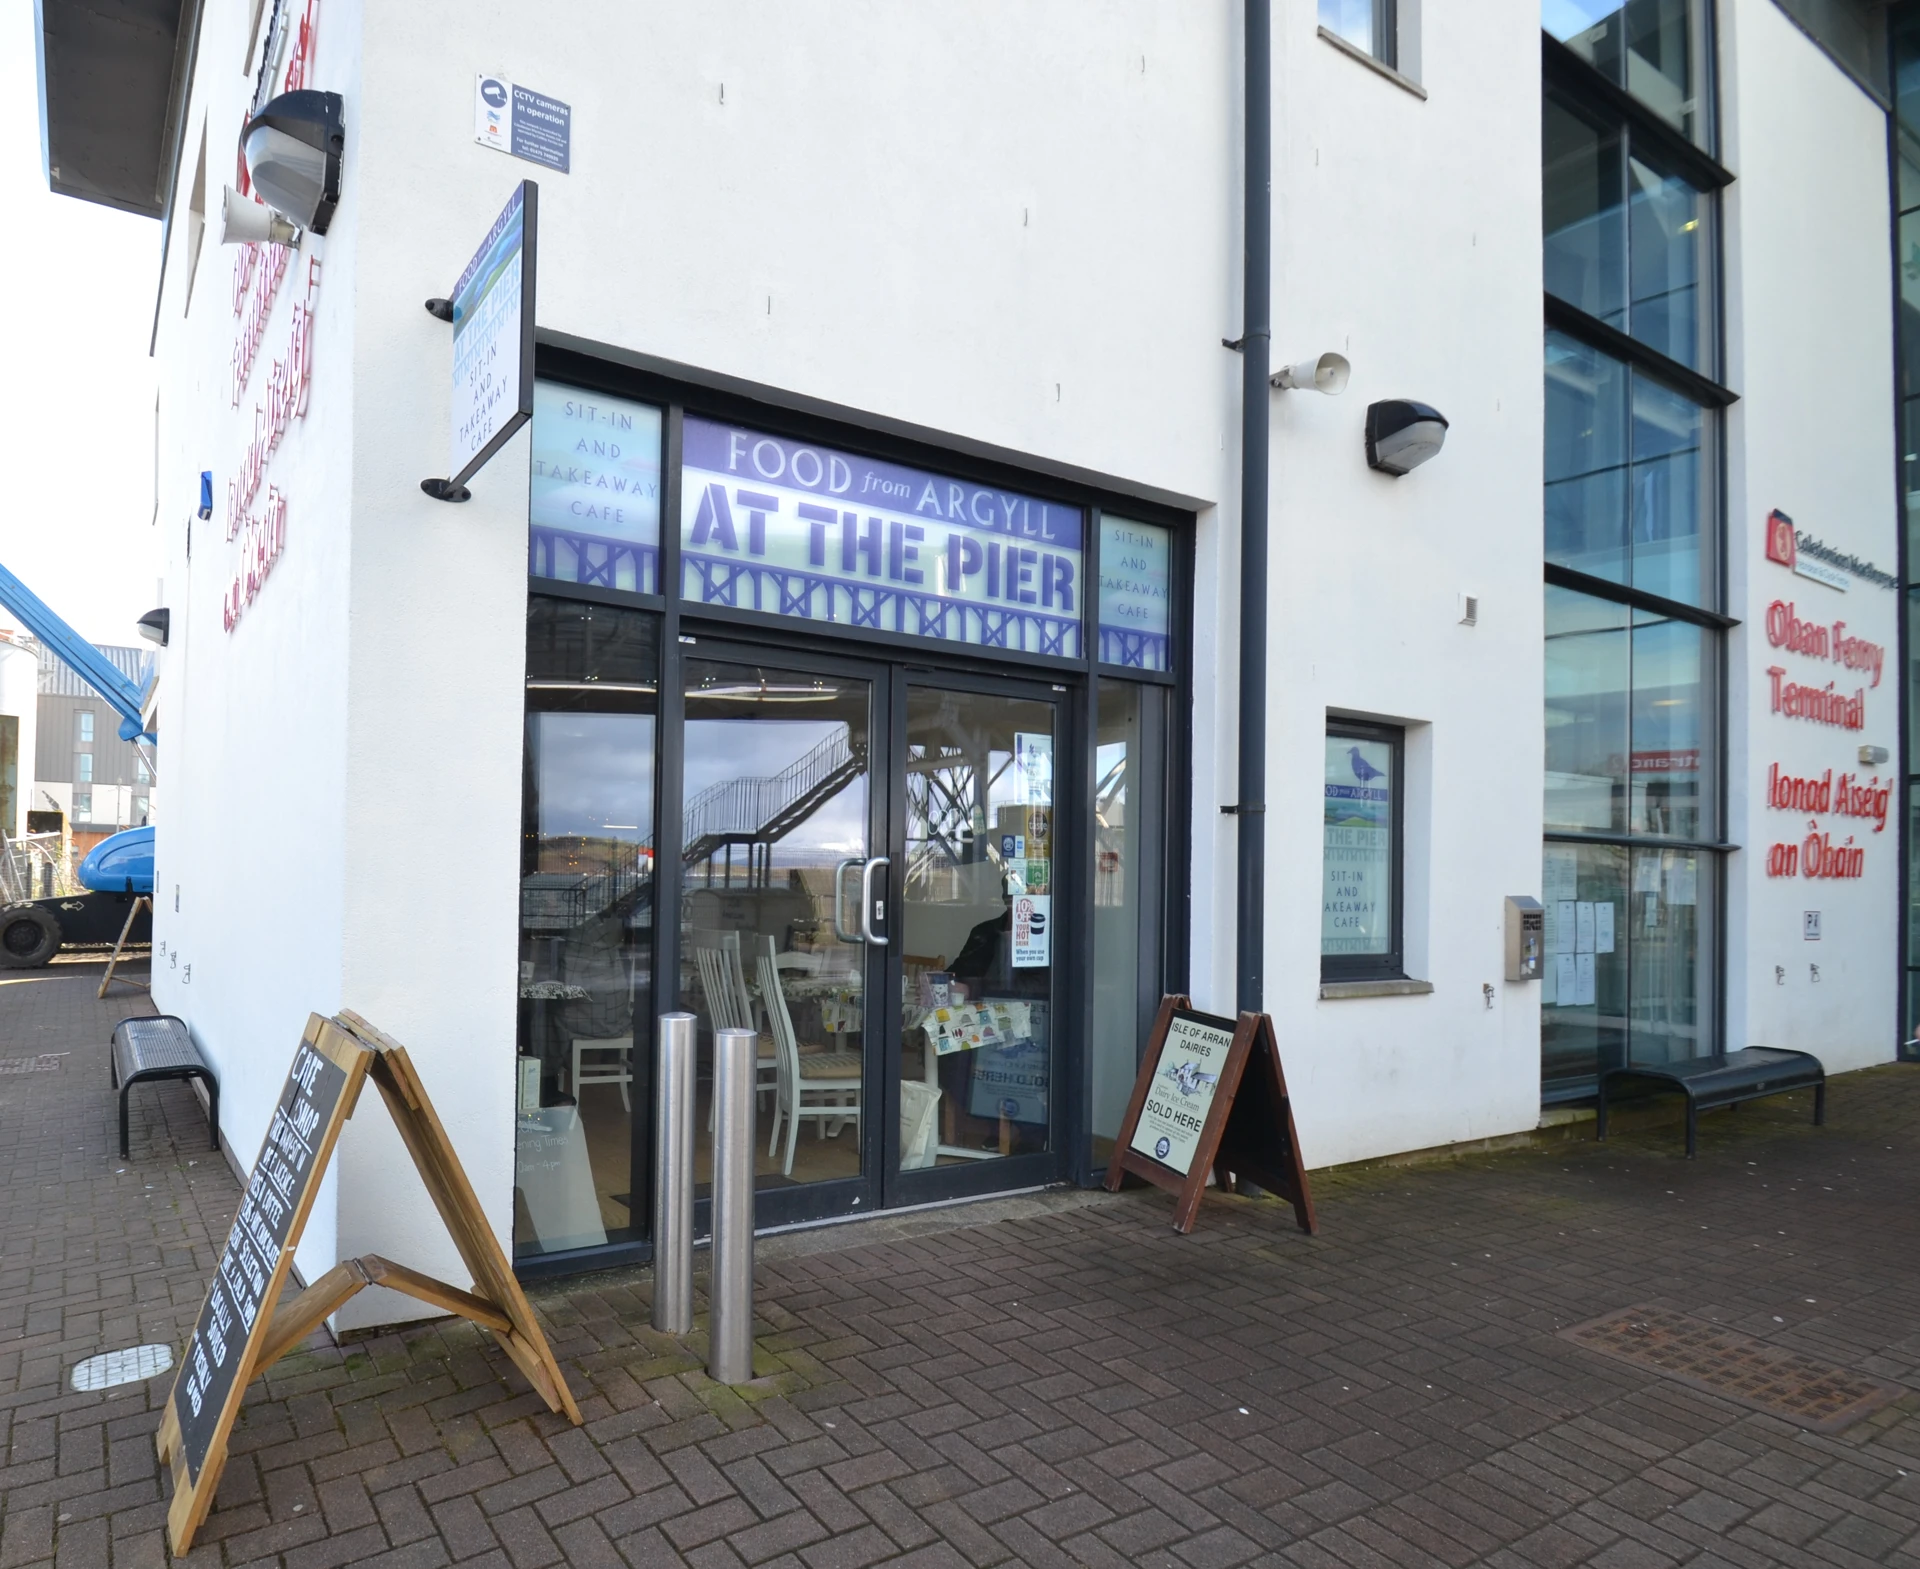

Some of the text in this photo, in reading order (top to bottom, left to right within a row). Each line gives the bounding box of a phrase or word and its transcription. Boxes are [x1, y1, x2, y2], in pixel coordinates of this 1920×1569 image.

[514, 90, 568, 116] CCTV cameras
[517, 102, 565, 126] in operation
[458, 257, 478, 293] FOOD
[487, 196, 516, 250] ARGYLL
[468, 301, 488, 344] THE
[492, 257, 520, 316] PIER
[470, 341, 497, 387] SIT-IN
[473, 373, 492, 405] AND
[459, 375, 508, 443] TAKEAWAY
[565, 401, 632, 430] SIT-IN
[471, 417, 493, 452] CAFE
[576, 438, 621, 458] AND
[536, 460, 657, 498] TAKEAWAY
[729, 430, 1056, 540] FOOD from ARGYLL
[571, 501, 624, 523] CAFE
[690, 482, 1075, 612] AT THE PIER
[1115, 529, 1153, 548] SIT-IN
[1120, 556, 1147, 570] AND
[1099, 574, 1168, 599] TAKEAWAY
[1118, 603, 1149, 619] CAFE
[1766, 599, 1885, 689] Oban Ferry
[1766, 665, 1864, 731] Terminal
[1325, 785, 1339, 797] OD
[1350, 788, 1382, 800] ARGYLL
[1767, 762, 1832, 813] Ionad
[1327, 828, 1386, 847] THE PIER
[1766, 842, 1798, 879] an
[1331, 871, 1363, 882] SIT-IN
[1336, 886, 1358, 897] AND
[1016, 899, 1035, 912] 10%
[1016, 911, 1031, 922] OFF
[1324, 901, 1376, 913] AKEAWAY
[1334, 916, 1360, 928] CAFE
[1016, 931, 1029, 940] HOT
[1171, 1022, 1231, 1048] ISLE OF ARRAN
[1180, 1040, 1212, 1057] DAIRIES
[292, 1046, 323, 1097] CAFE
[1155, 1086, 1200, 1112] Dairy Ice Cream
[292, 1099, 320, 1141] SHOP
[1146, 1099, 1173, 1119] SOLD
[1174, 1111, 1202, 1133] HERE
[262, 1189, 283, 1229] COFFEE
